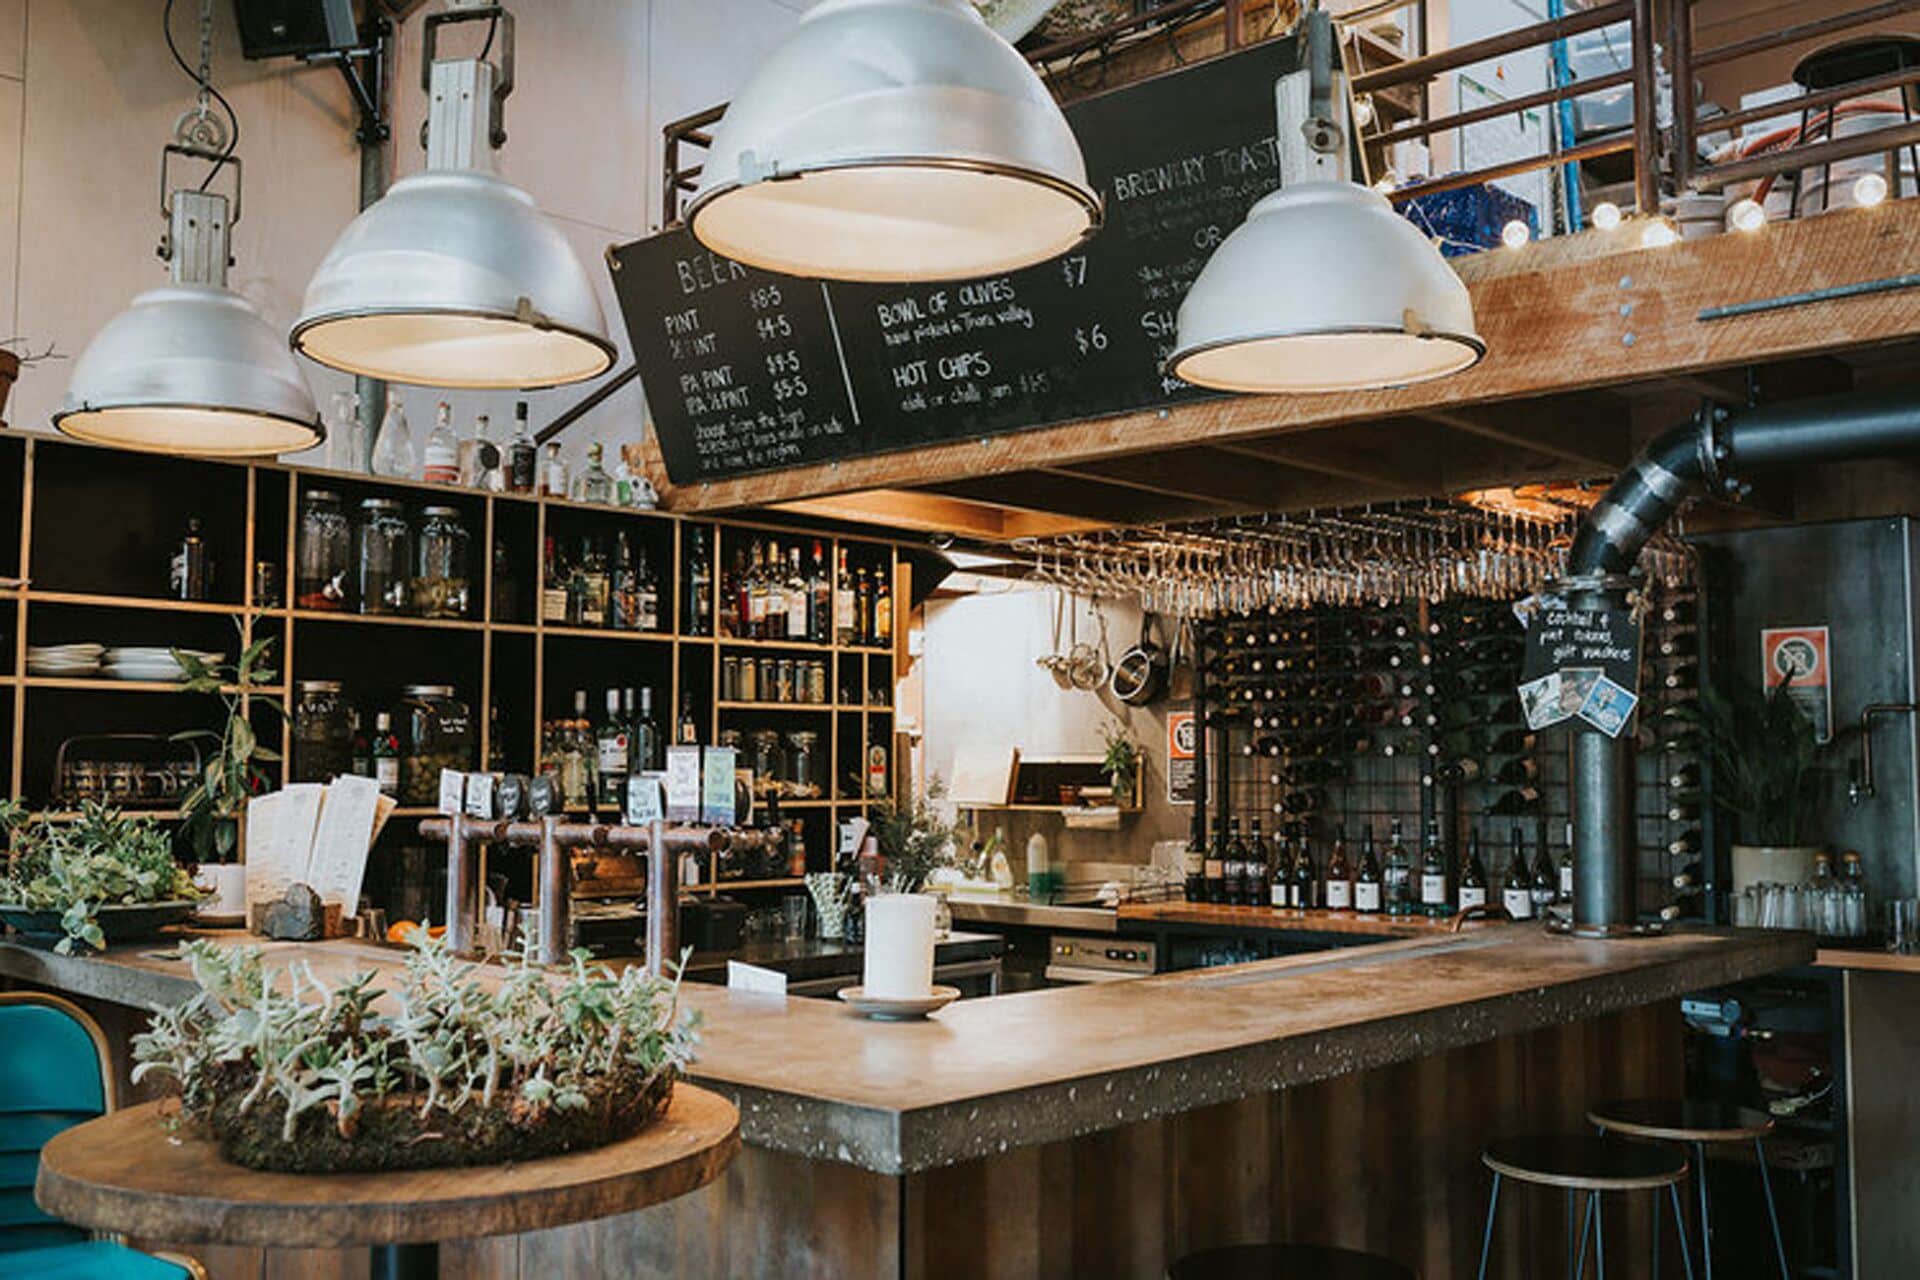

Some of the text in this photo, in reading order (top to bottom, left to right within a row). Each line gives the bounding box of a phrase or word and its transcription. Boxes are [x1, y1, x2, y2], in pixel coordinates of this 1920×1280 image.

[1113, 156, 1206, 201] BREWERY
[1194, 225, 1222, 249] OR
[877, 298, 927, 328] BOWL
[928, 290, 949, 315] OF
[958, 277, 1016, 306] OLIVES
[664, 309, 700, 335] PINT
[701, 365, 734, 390] PINT
[892, 360, 928, 388] HOT
[937, 351, 992, 380] CHIPS
